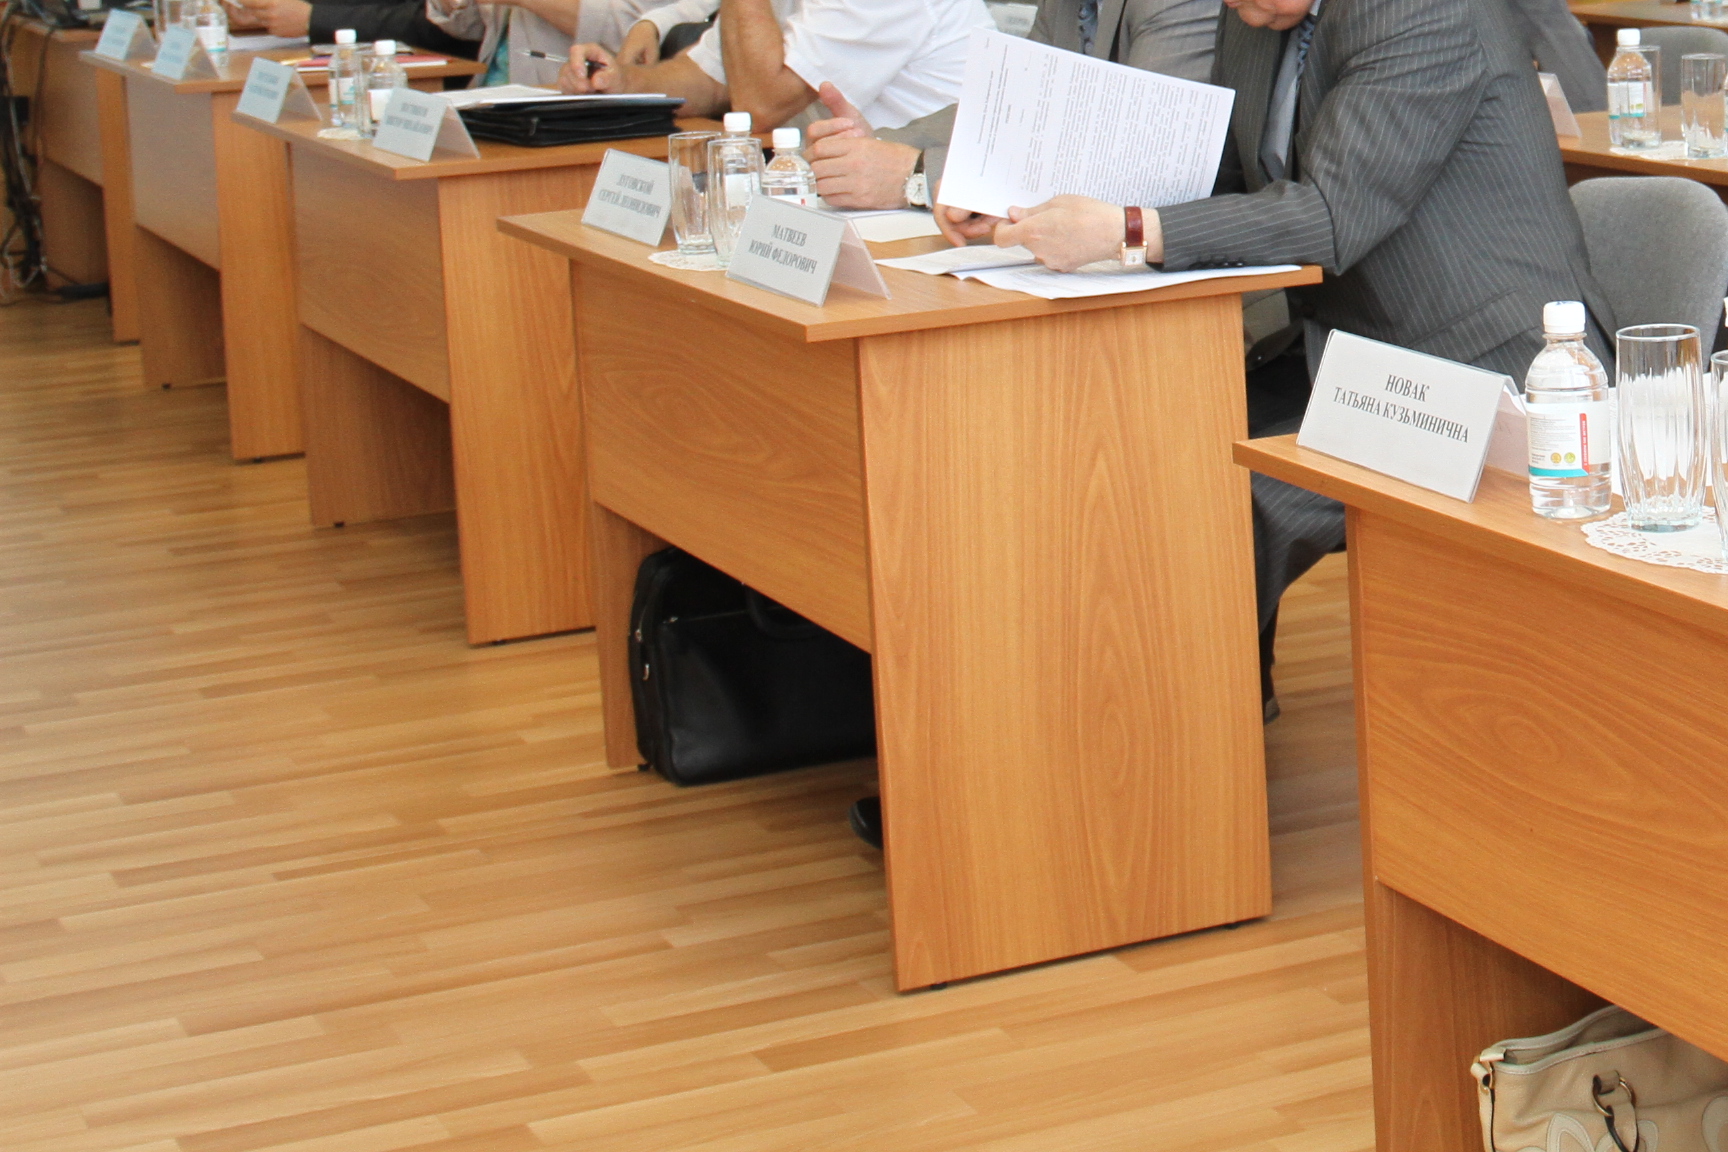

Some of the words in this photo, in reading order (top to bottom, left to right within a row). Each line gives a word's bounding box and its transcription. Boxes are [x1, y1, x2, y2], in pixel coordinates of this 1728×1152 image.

[772, 224, 808, 247] МАТВЕЕВ
[748, 239, 773, 258] ЮРИЙ
[771, 249, 817, 274] ФЕДОРОВИЧ
[1385, 374, 1430, 402] НОВАК
[1333, 386, 1381, 416] ТАТЬЯНА
[1382, 403, 1469, 443] КУЗЬМИНИЧНА
